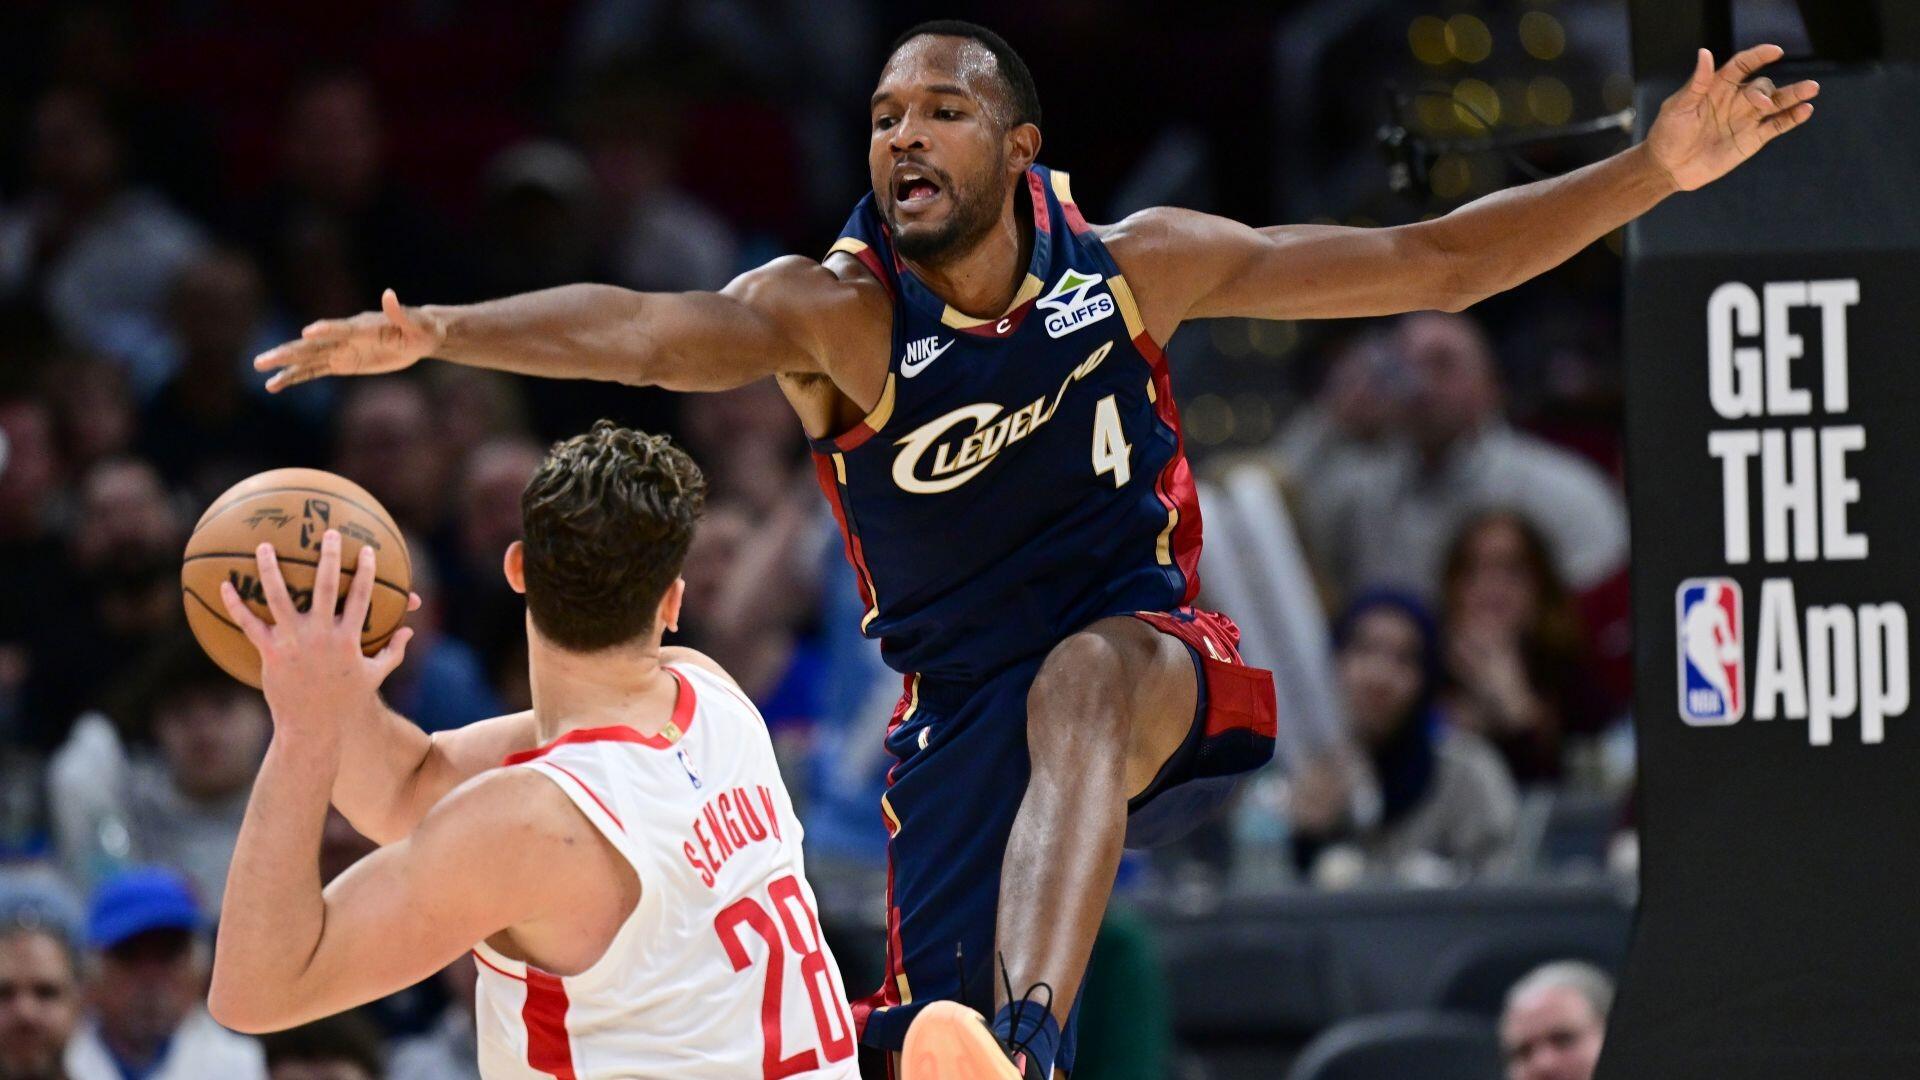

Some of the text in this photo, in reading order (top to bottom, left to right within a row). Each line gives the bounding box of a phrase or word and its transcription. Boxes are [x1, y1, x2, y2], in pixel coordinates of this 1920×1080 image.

[906, 335, 940, 363] NIKE
[1048, 299, 1112, 333] CLIFFS
[1707, 279, 1860, 419] GET
[1092, 394, 1133, 489] 4
[1707, 425, 1869, 564] THE
[1753, 578, 1910, 746] App
[714, 875, 855, 1080] 28
